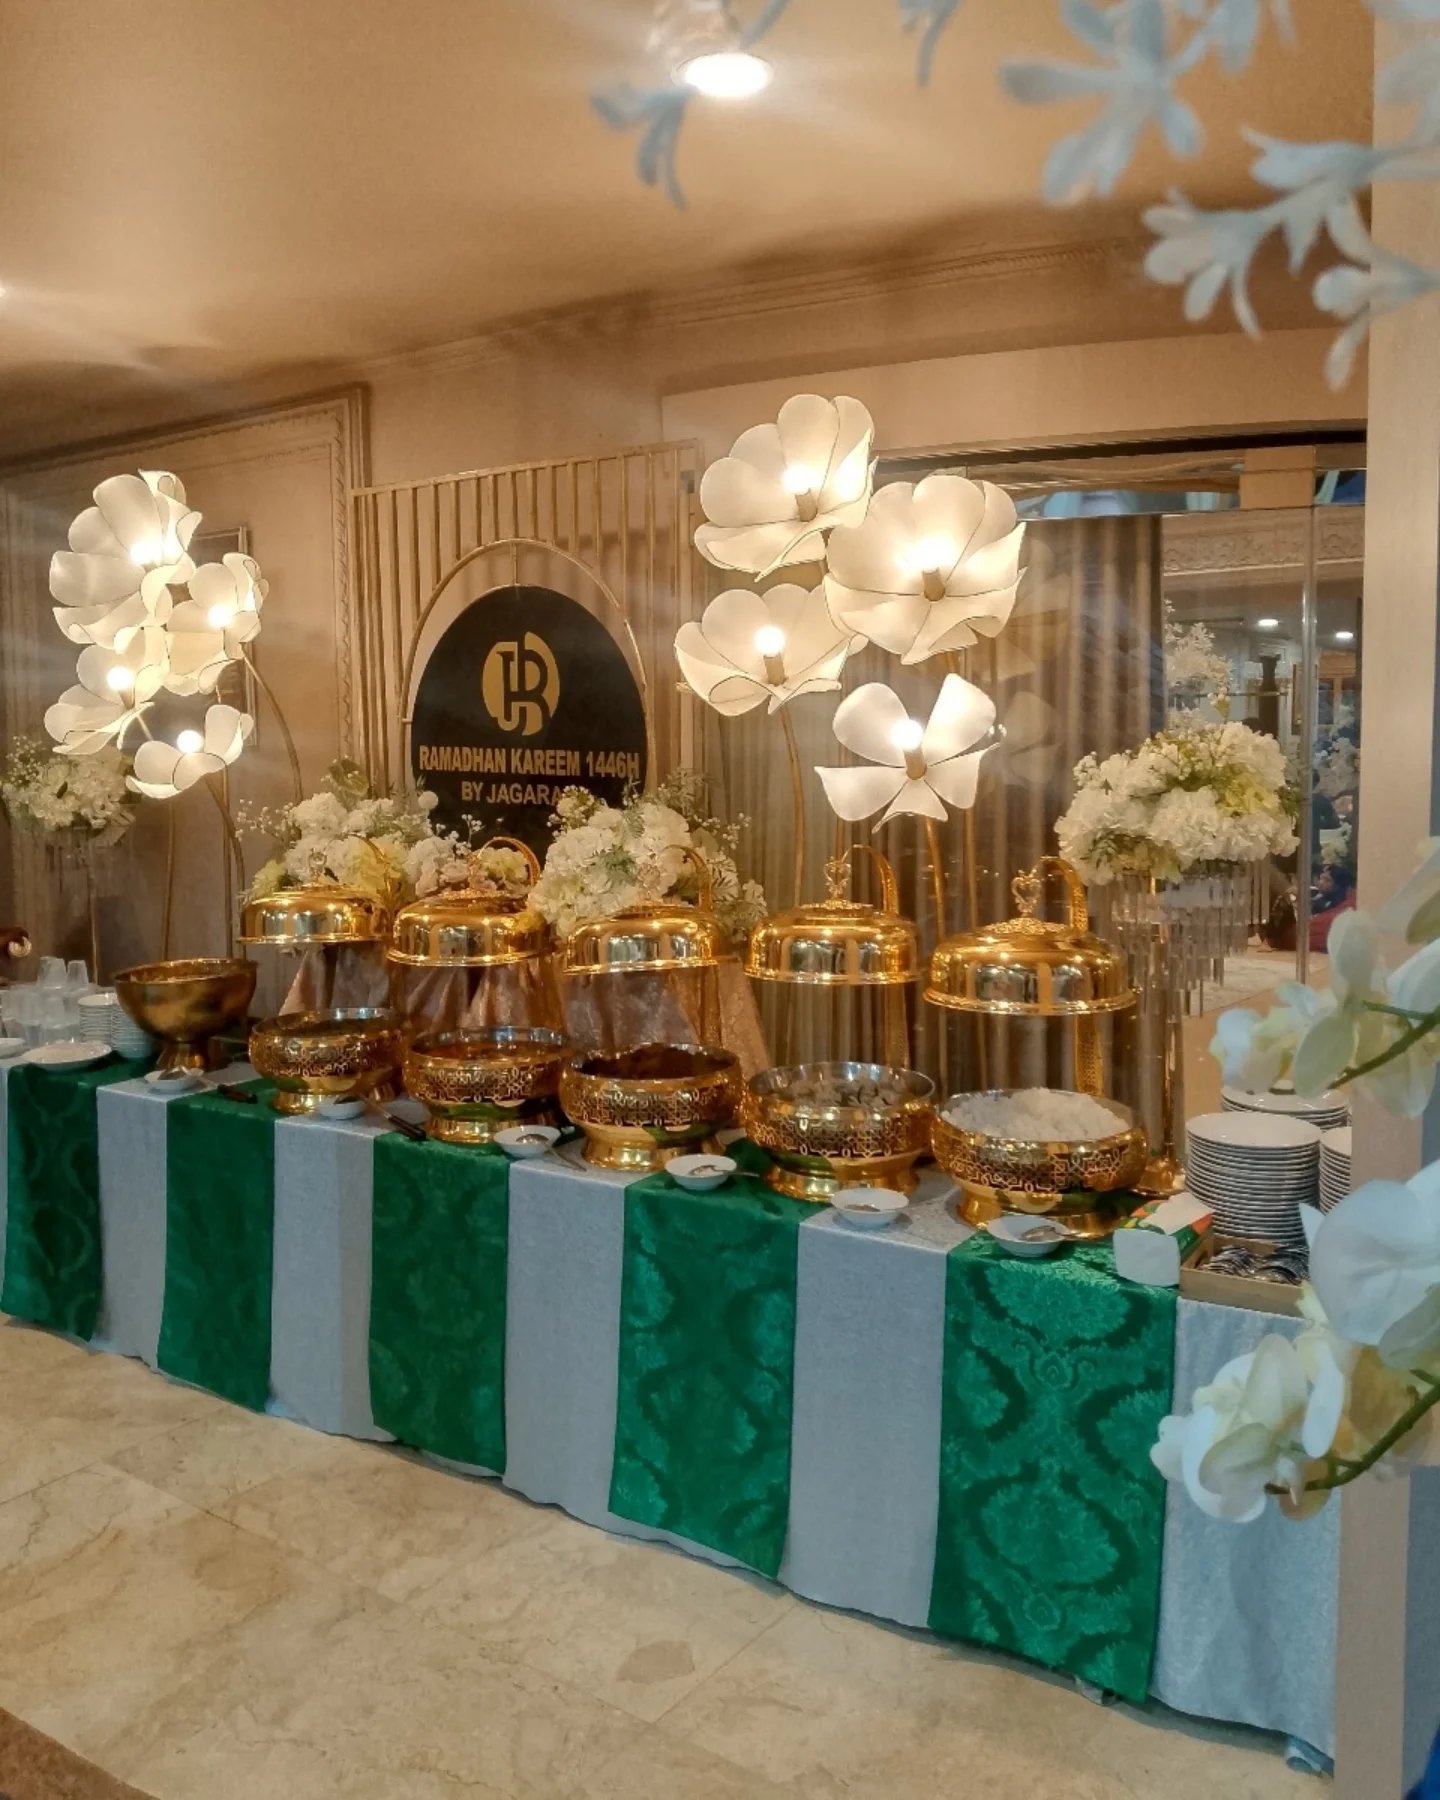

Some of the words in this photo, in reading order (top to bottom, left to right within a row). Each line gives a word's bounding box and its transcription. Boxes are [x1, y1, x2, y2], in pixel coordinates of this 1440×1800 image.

[419, 745, 506, 773] RAMADHAN
[511, 748, 580, 776] KAREEM
[586, 751, 640, 778] 1446H
[461, 781, 484, 801] BY
[486, 782, 562, 805] JAGARA
